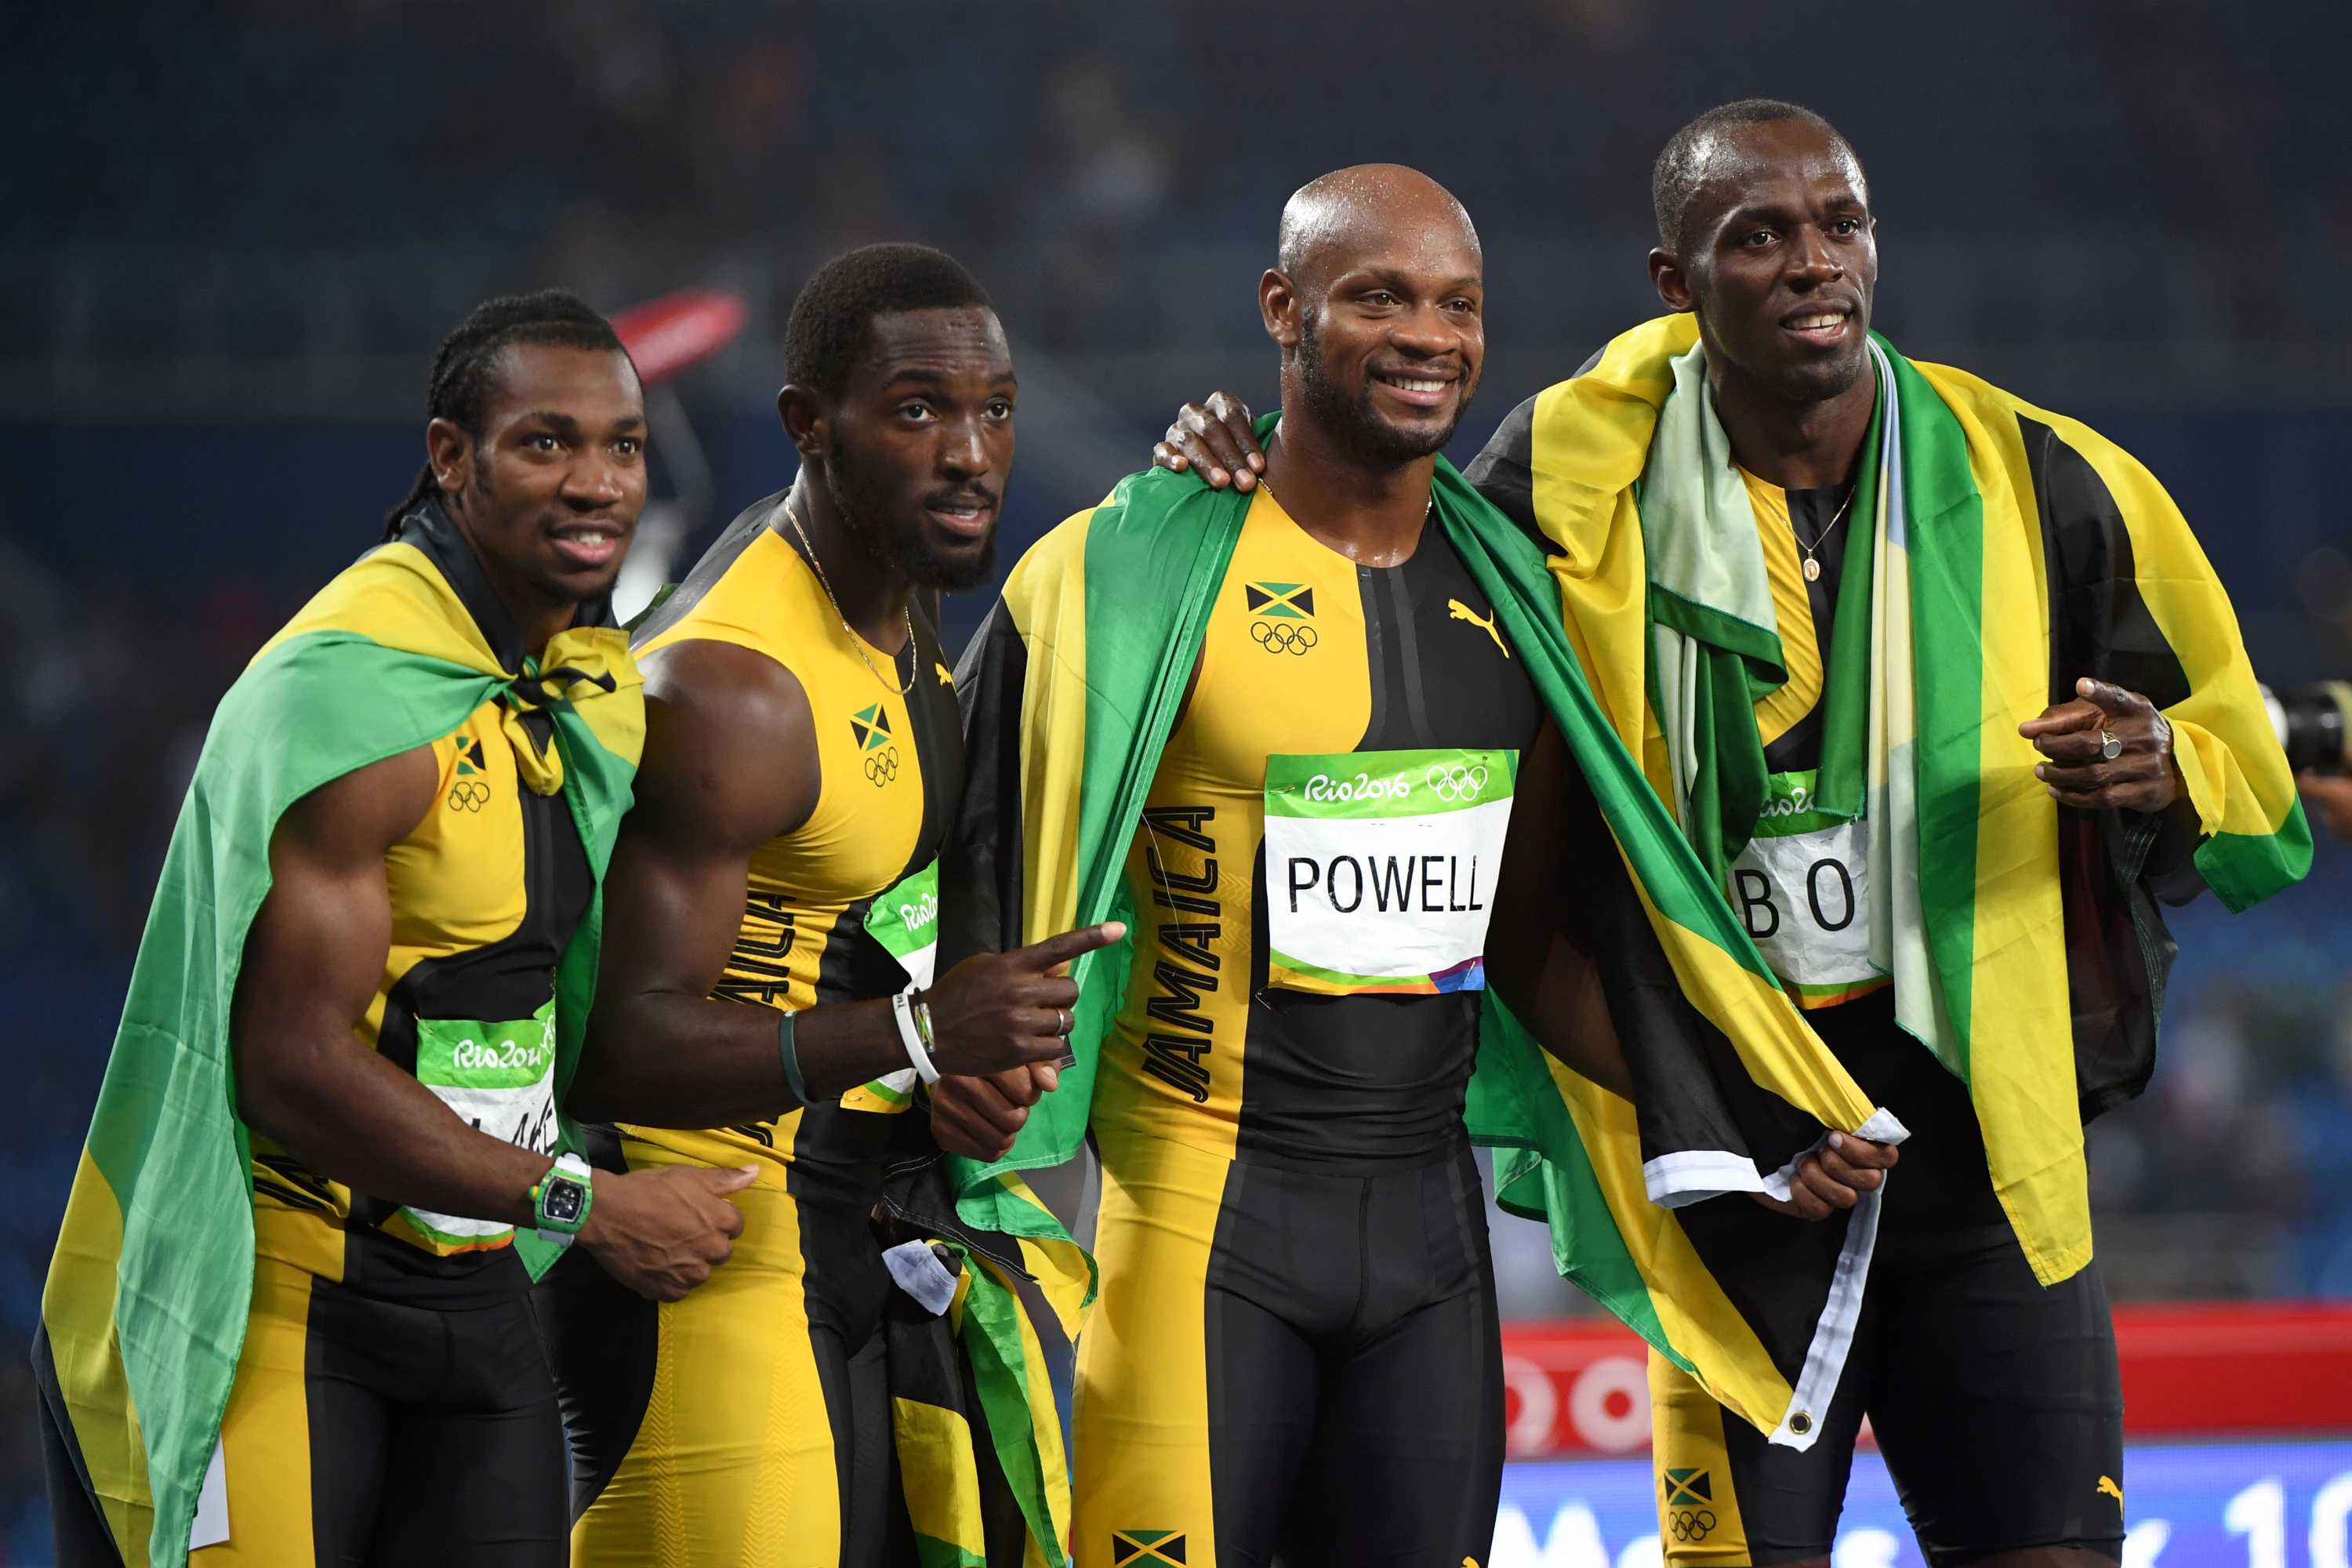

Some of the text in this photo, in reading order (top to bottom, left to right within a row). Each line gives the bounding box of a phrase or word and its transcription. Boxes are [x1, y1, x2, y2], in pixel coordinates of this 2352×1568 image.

[1305, 771, 1411, 801] Rio2016
[1288, 855, 1483, 913] POWELL
[1142, 806, 1220, 1103] JAMAICA
